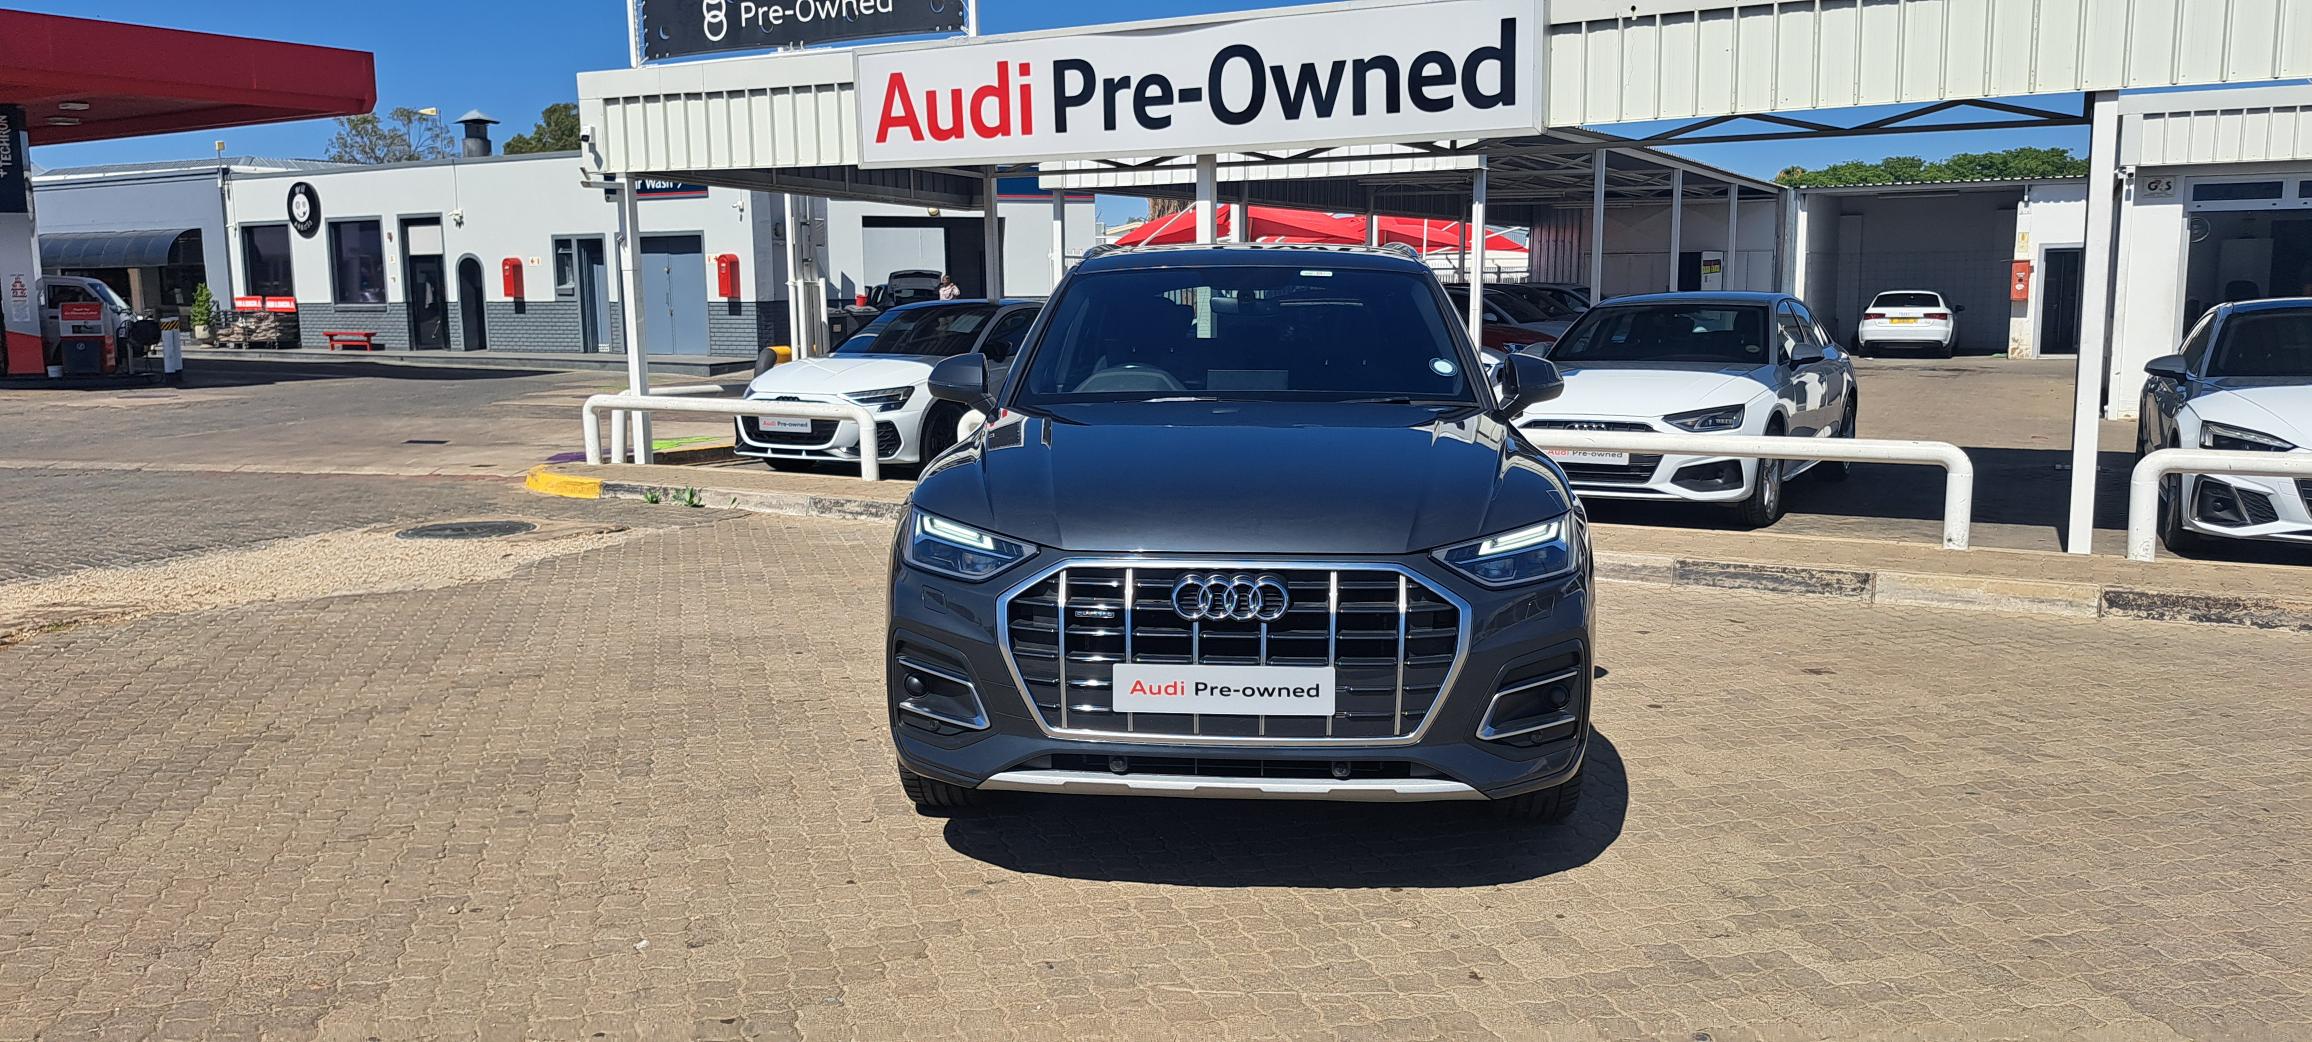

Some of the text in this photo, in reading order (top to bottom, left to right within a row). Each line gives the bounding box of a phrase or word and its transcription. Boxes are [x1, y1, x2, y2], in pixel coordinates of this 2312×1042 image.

[875, 17, 1517, 144] Audi Pre-Owned
[1130, 680, 1320, 698] Audi Pre-owned
